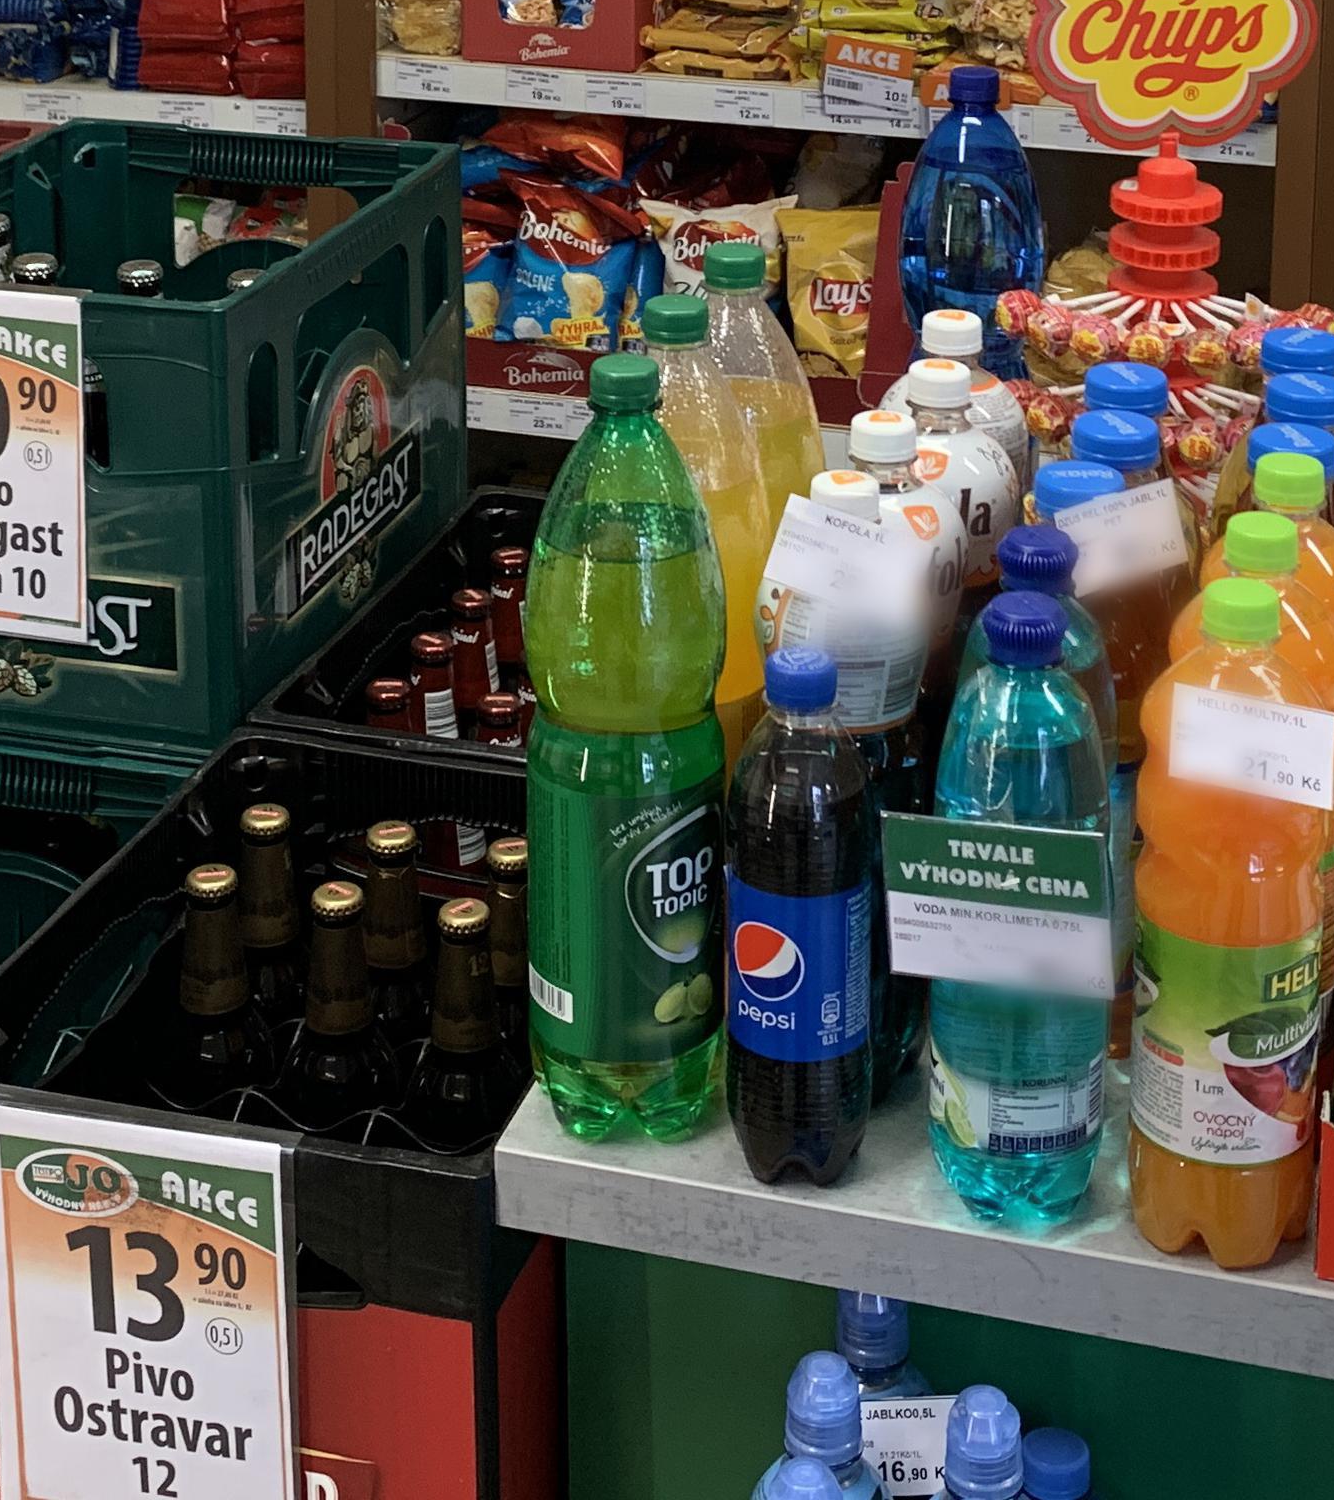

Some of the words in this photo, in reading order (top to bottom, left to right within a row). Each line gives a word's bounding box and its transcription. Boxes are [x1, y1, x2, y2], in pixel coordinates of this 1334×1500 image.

[519, 44, 570, 63] Bohemia
[836, 41, 903, 72] AKCE
[519, 212, 613, 258] Bohemia
[503, 365, 585, 387] Bohemia
[18, 378, 57, 414] 90
[299, 441, 416, 600] RADEGAST
[12, 566, 47, 599] 10
[948, 839, 1034, 866] TRVALE
[646, 845, 713, 897] TOP
[901, 859, 1023, 890] VÝHODNÁ
[1026, 874, 1089, 900] CENA
[653, 883, 709, 915] TOPIC
[915, 903, 948, 917] VODA
[737, 1001, 796, 1031] pepsi
[1206, 1123, 1245, 1142] nápoj
[66, 1164, 122, 1193] JO
[163, 1171, 258, 1228] AKCE
[66, 1226, 186, 1342] 13
[194, 1243, 247, 1290] 90
[105, 1349, 194, 1400] Pivo
[55, 1386, 253, 1461] Ostravar
[132, 1457, 177, 1499] 12
